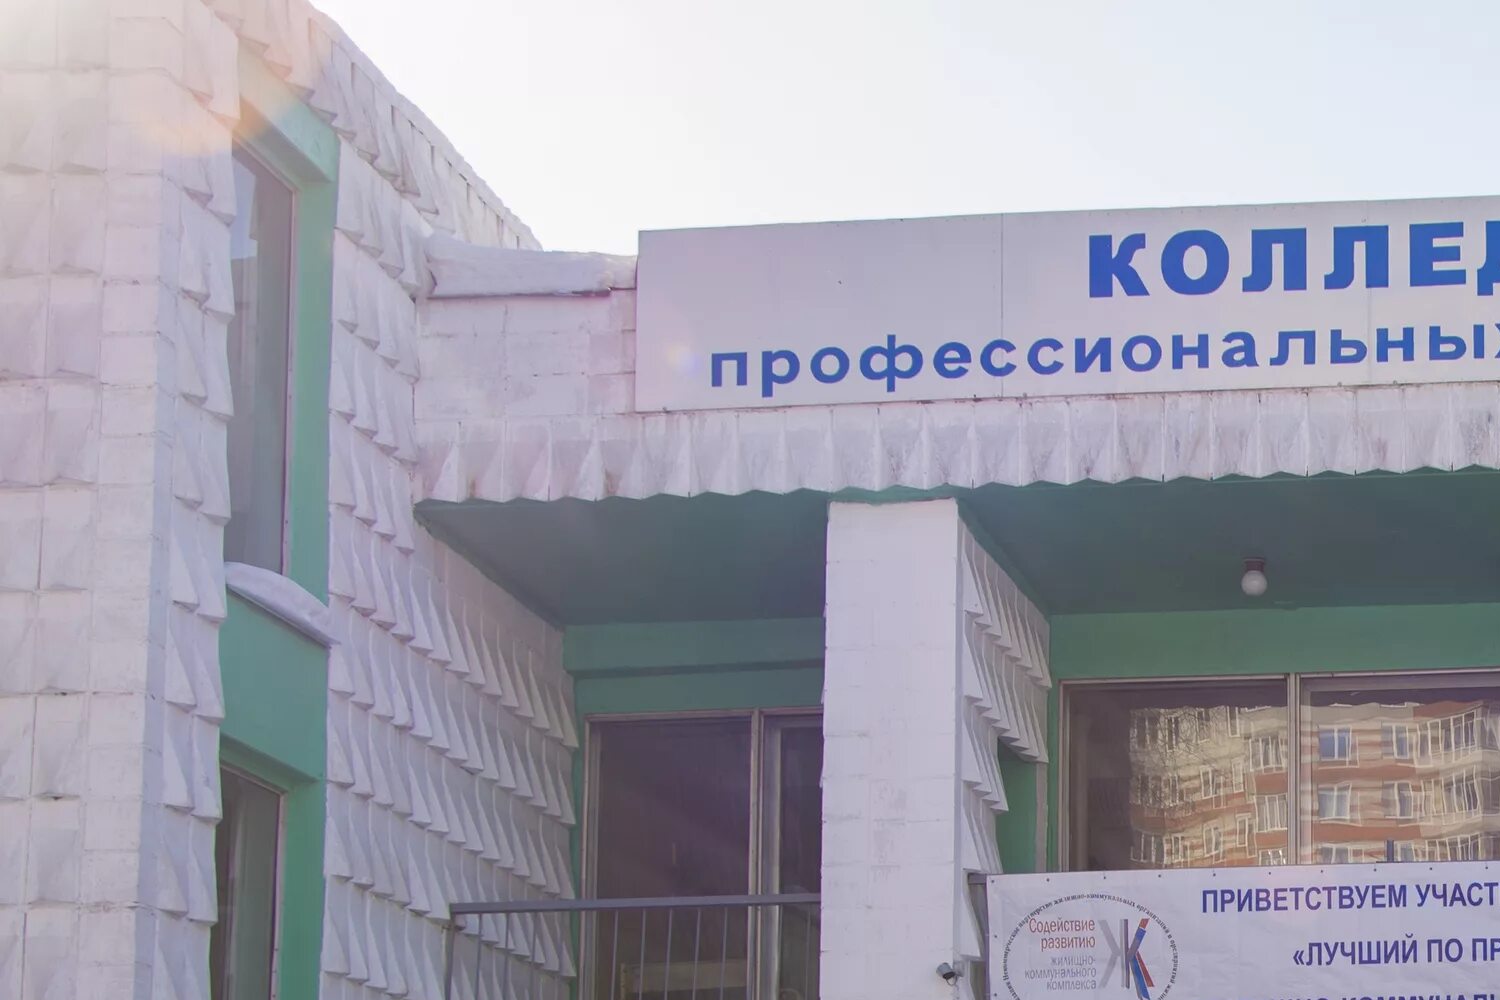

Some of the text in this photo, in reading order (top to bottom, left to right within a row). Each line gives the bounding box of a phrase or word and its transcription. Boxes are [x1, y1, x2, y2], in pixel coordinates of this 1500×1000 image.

[1202, 884, 1407, 914] ПРИВЕТСТВУЕМ
[1028, 917, 1096, 935] Содействие
[1041, 936, 1096, 952] развитию
[1292, 932, 1419, 967] «ЛУЧШИЙ
[1427, 938, 1464, 963] ПО
[1050, 955, 1096, 967] жилищно-
[1024, 967, 1097, 982] коммунального
[1046, 980, 1097, 991] комплекса
